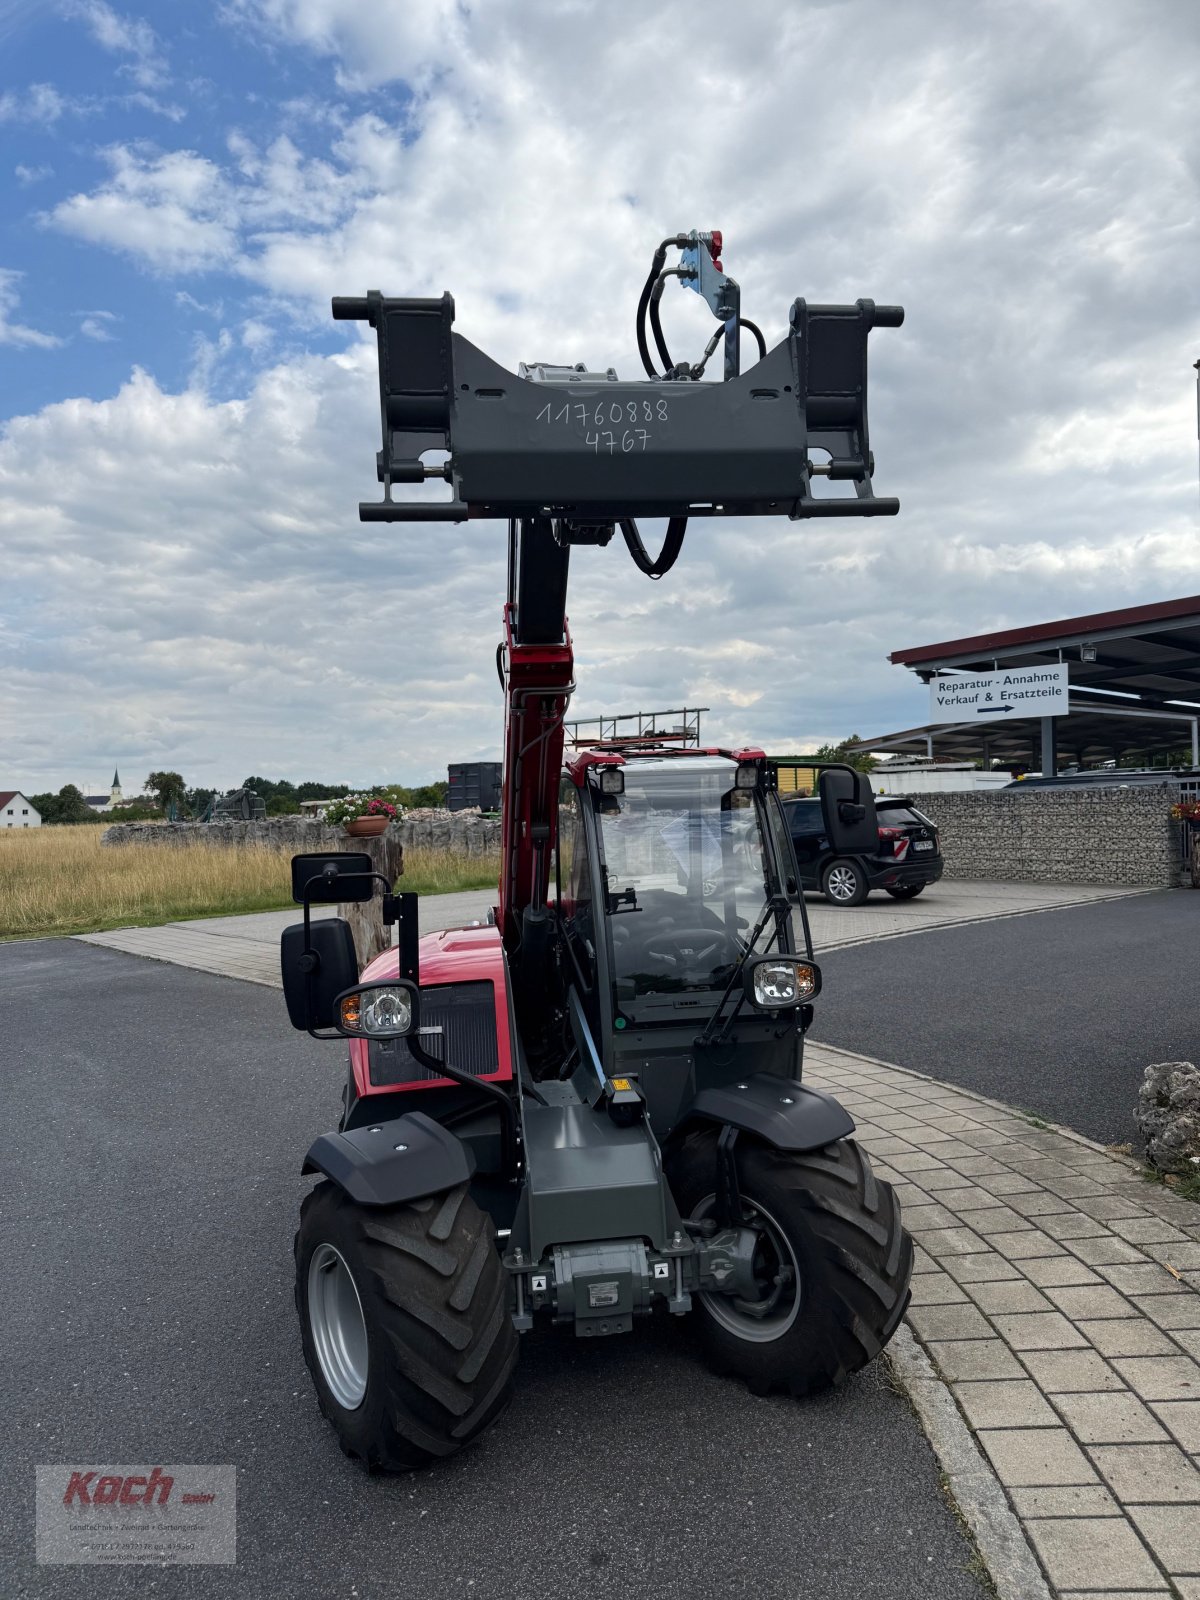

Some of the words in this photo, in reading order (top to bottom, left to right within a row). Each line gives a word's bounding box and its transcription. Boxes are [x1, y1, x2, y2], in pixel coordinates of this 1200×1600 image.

[536, 399, 668, 427] 11760888
[585, 429, 652, 456] 4767
[938, 679, 993, 693] Reparatur
[1003, 673, 1060, 686] Annahme
[937, 693, 979, 706] Verkauf
[984, 692, 993, 702] &
[1000, 686, 1062, 700] Ersatzteile
